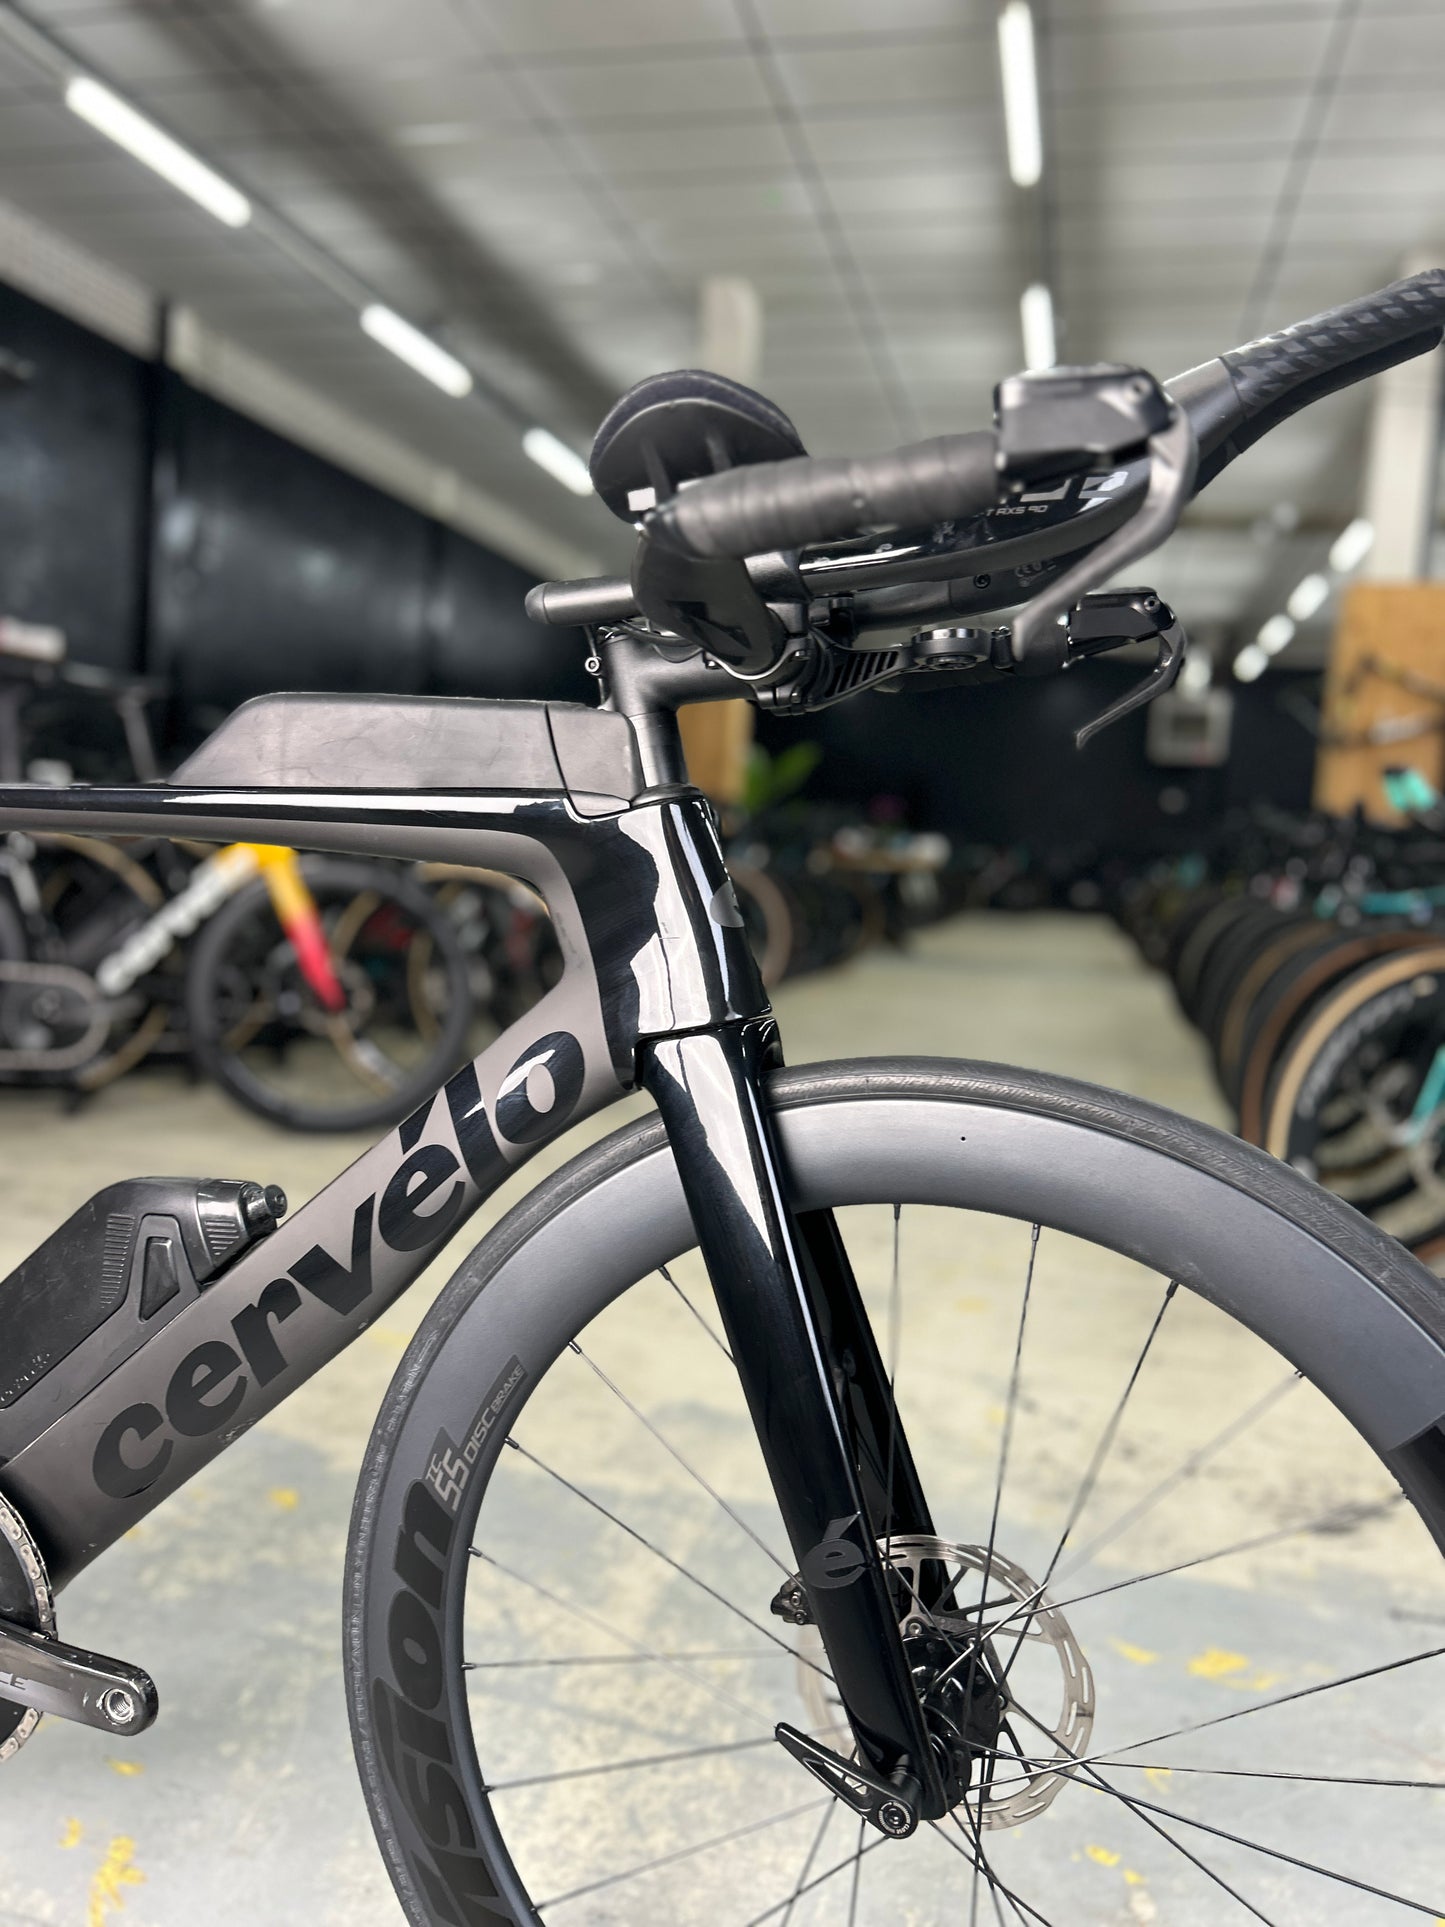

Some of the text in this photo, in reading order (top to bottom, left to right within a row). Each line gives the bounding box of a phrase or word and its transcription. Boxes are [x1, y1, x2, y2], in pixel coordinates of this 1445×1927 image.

[93, 1031, 585, 1499] cervélo
[463, 1365, 526, 1464] DISC BRAKE
[425, 1453, 443, 1482] TC
[434, 1447, 470, 1512] 55
